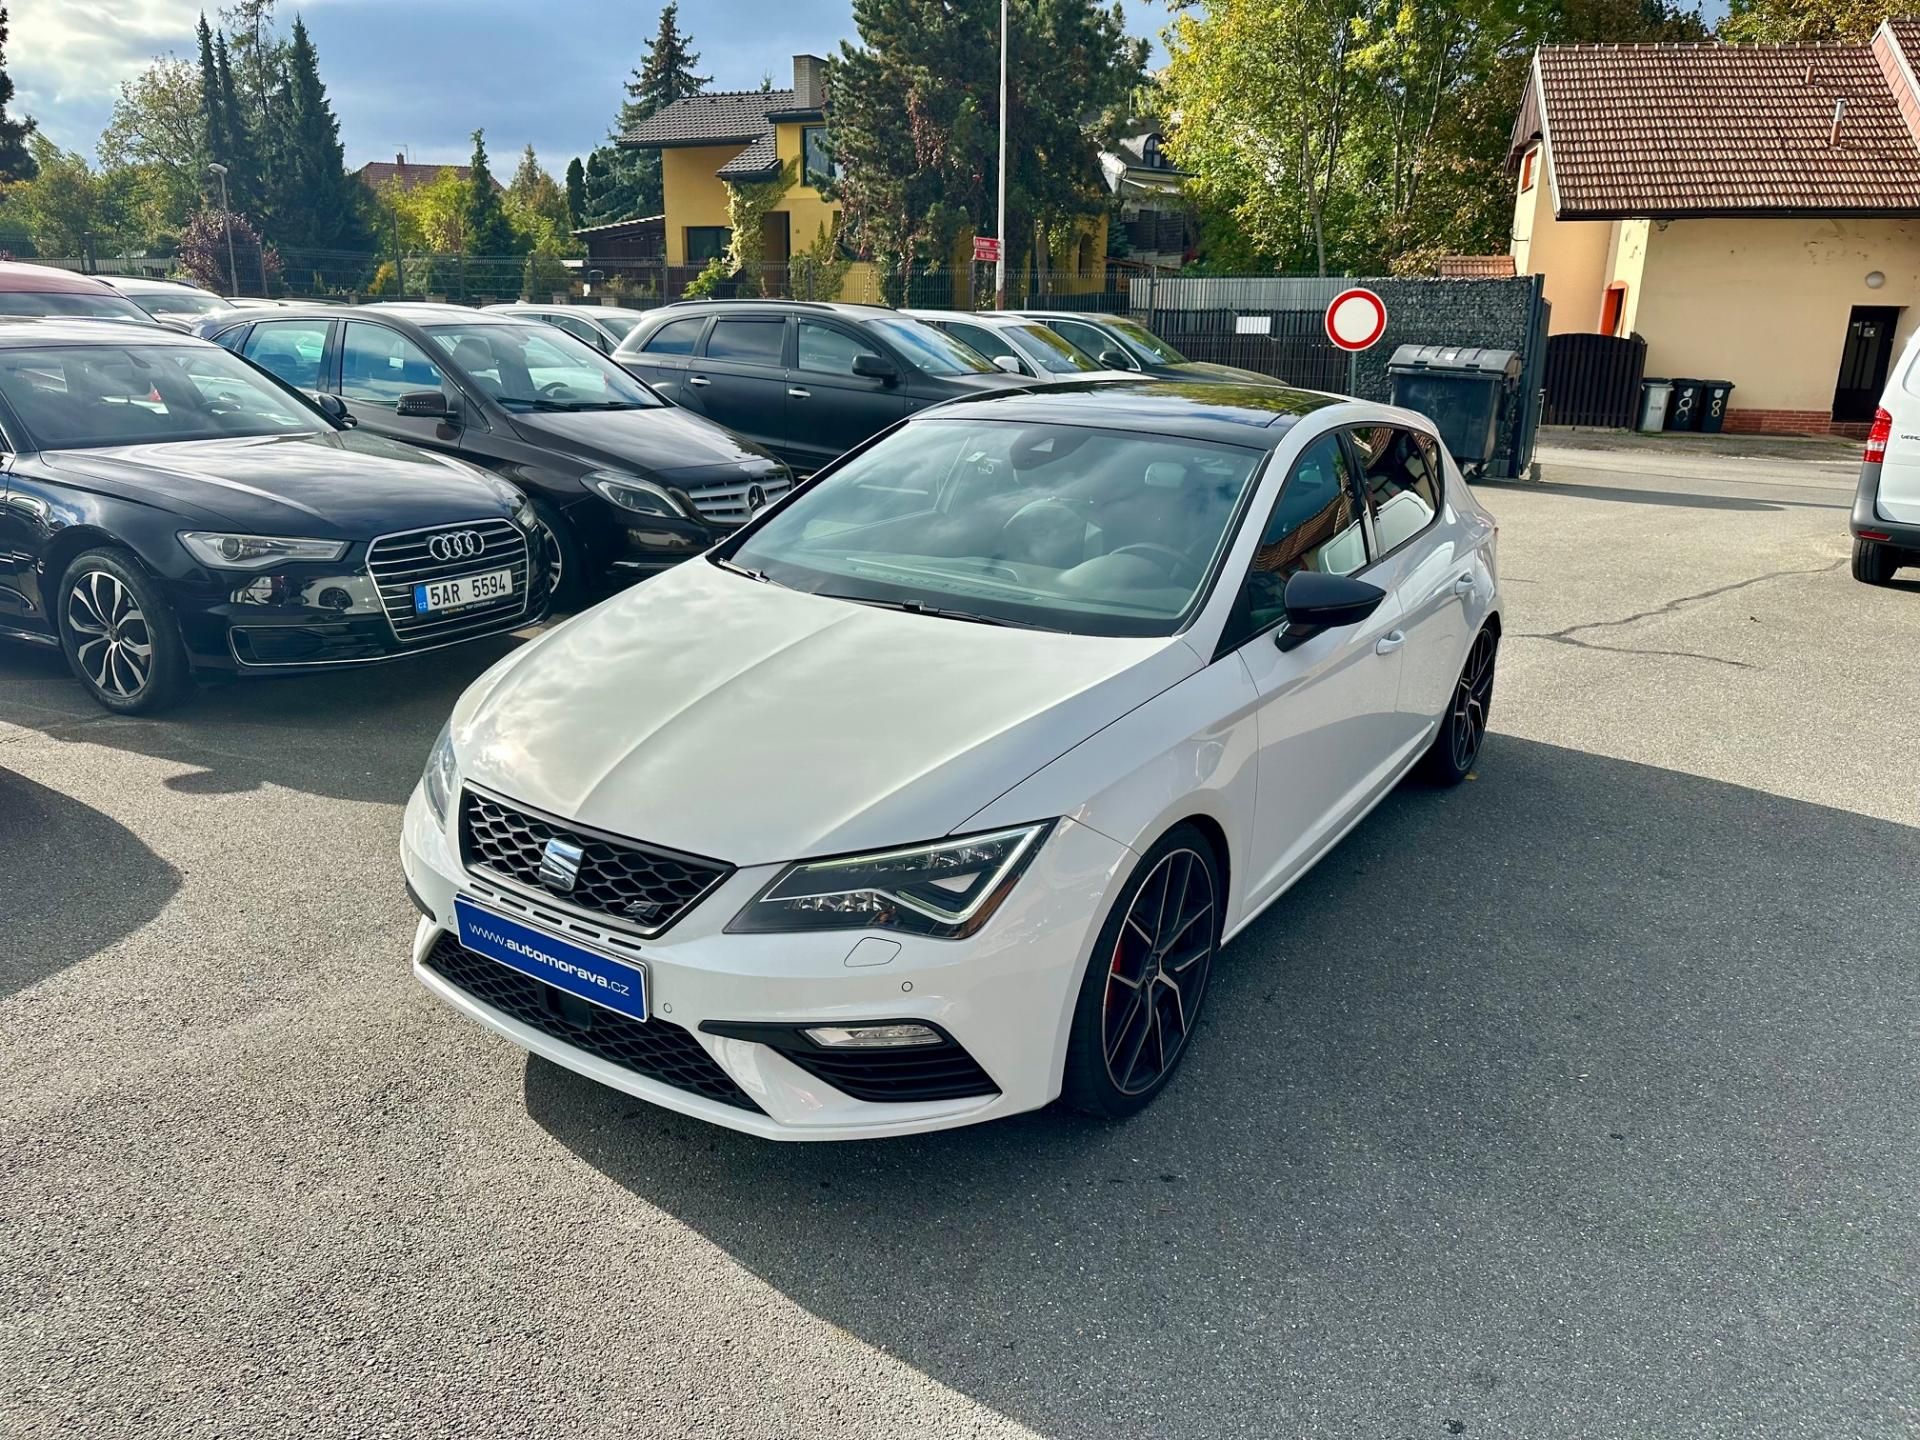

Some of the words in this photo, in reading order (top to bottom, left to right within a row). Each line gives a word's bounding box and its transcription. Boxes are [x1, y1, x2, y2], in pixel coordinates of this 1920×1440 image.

[1711, 399, 1722, 417] 8
[430, 583, 461, 606] 5AR
[471, 574, 506, 598] 5594
[468, 922, 631, 997] www.automorava.cz
